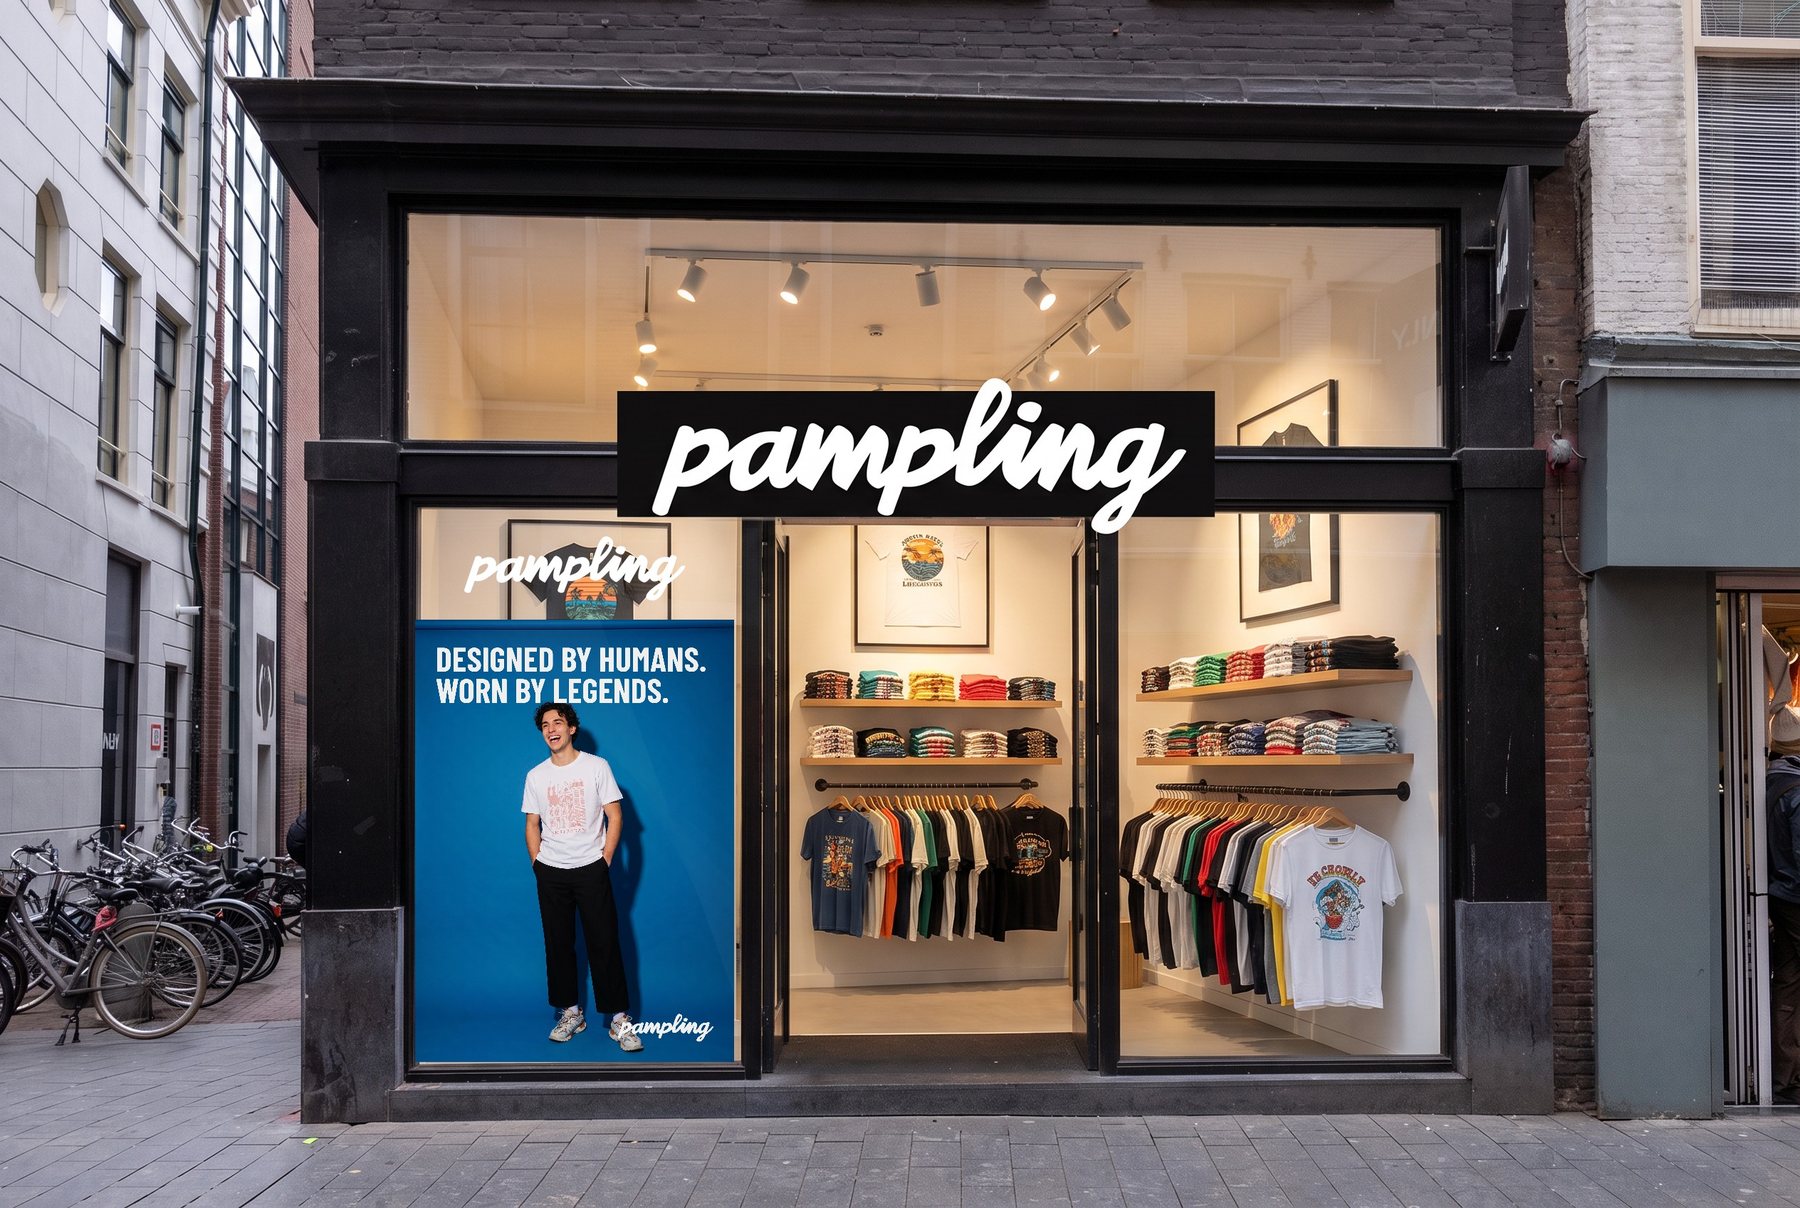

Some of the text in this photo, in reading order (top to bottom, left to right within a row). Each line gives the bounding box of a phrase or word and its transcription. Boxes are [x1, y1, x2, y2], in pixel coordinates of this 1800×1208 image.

[652, 377, 1187, 535] pampling
[464, 535, 686, 601] pampling
[436, 647, 706, 673] DESIGNED BY HUMANS.
[436, 678, 669, 704] WORN BY LEGENDS.
[617, 1013, 714, 1042] pampling
